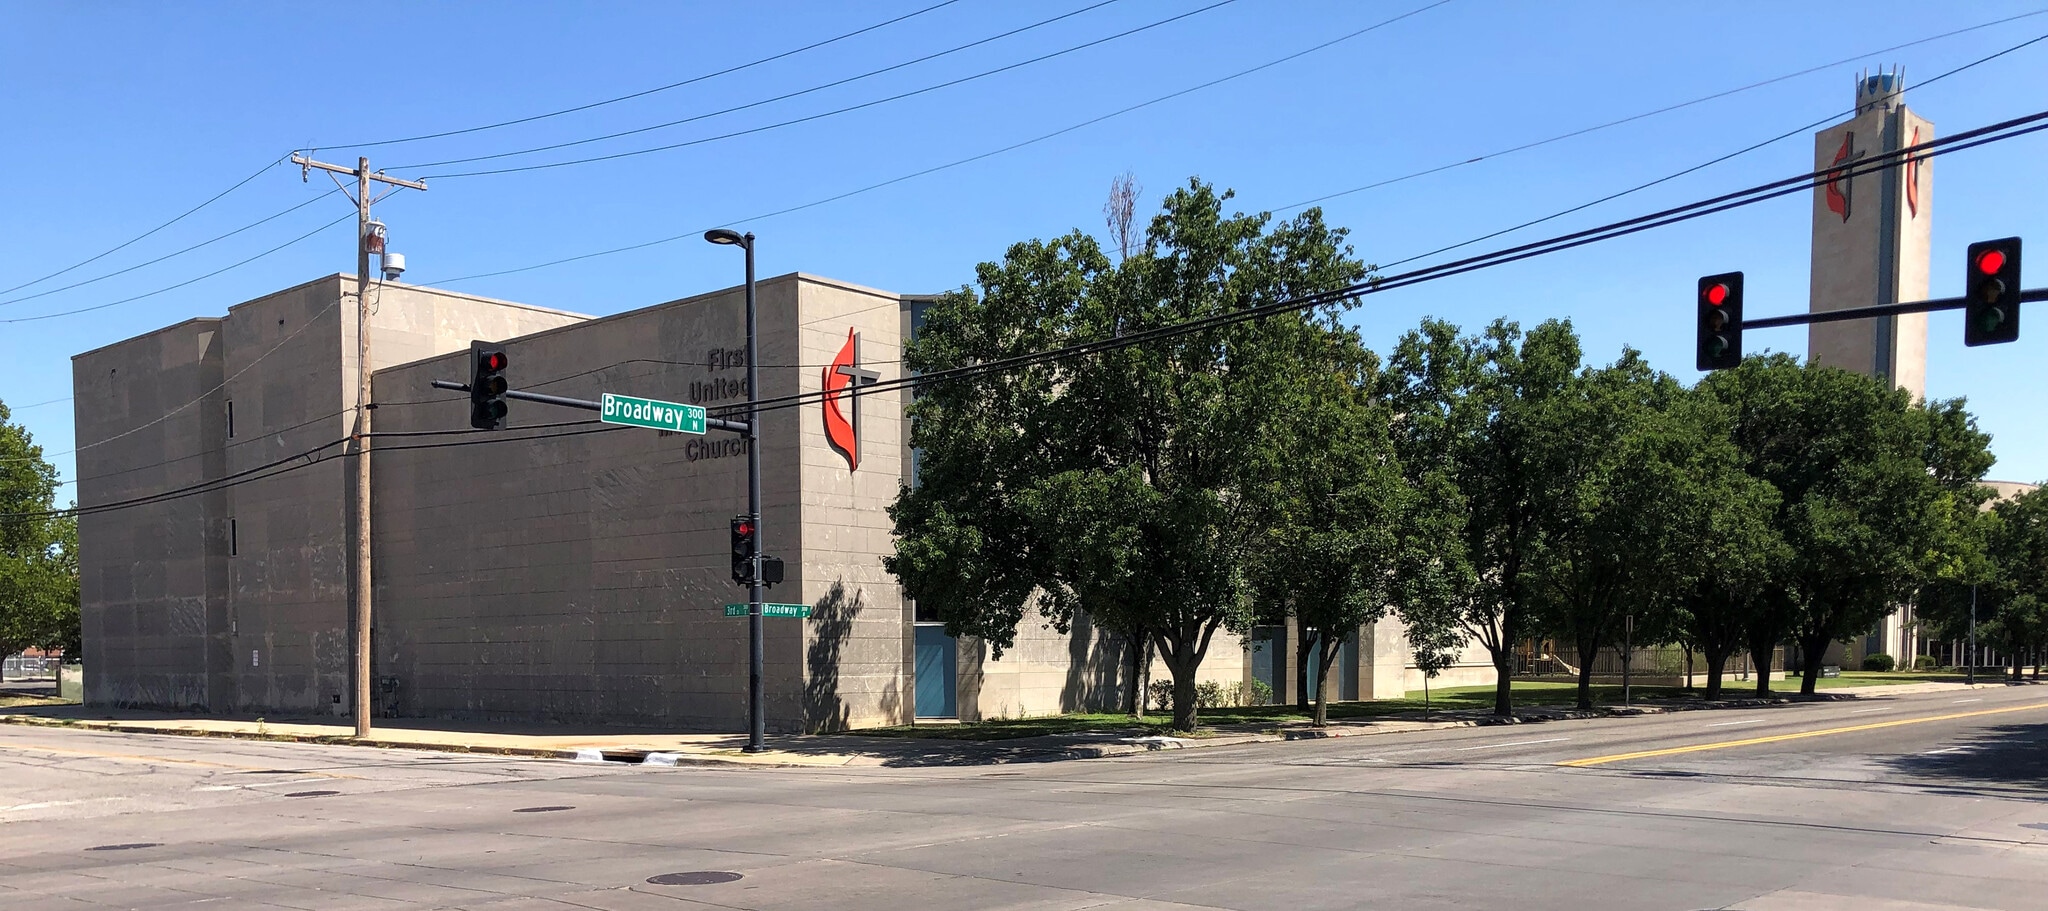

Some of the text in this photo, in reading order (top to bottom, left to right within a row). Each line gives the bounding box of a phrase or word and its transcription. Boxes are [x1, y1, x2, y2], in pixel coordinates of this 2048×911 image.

[604, 395, 683, 430] Broadway
[687, 408, 703, 420] 300
[692, 420, 698, 431] N
[764, 604, 798, 617] Broadway
